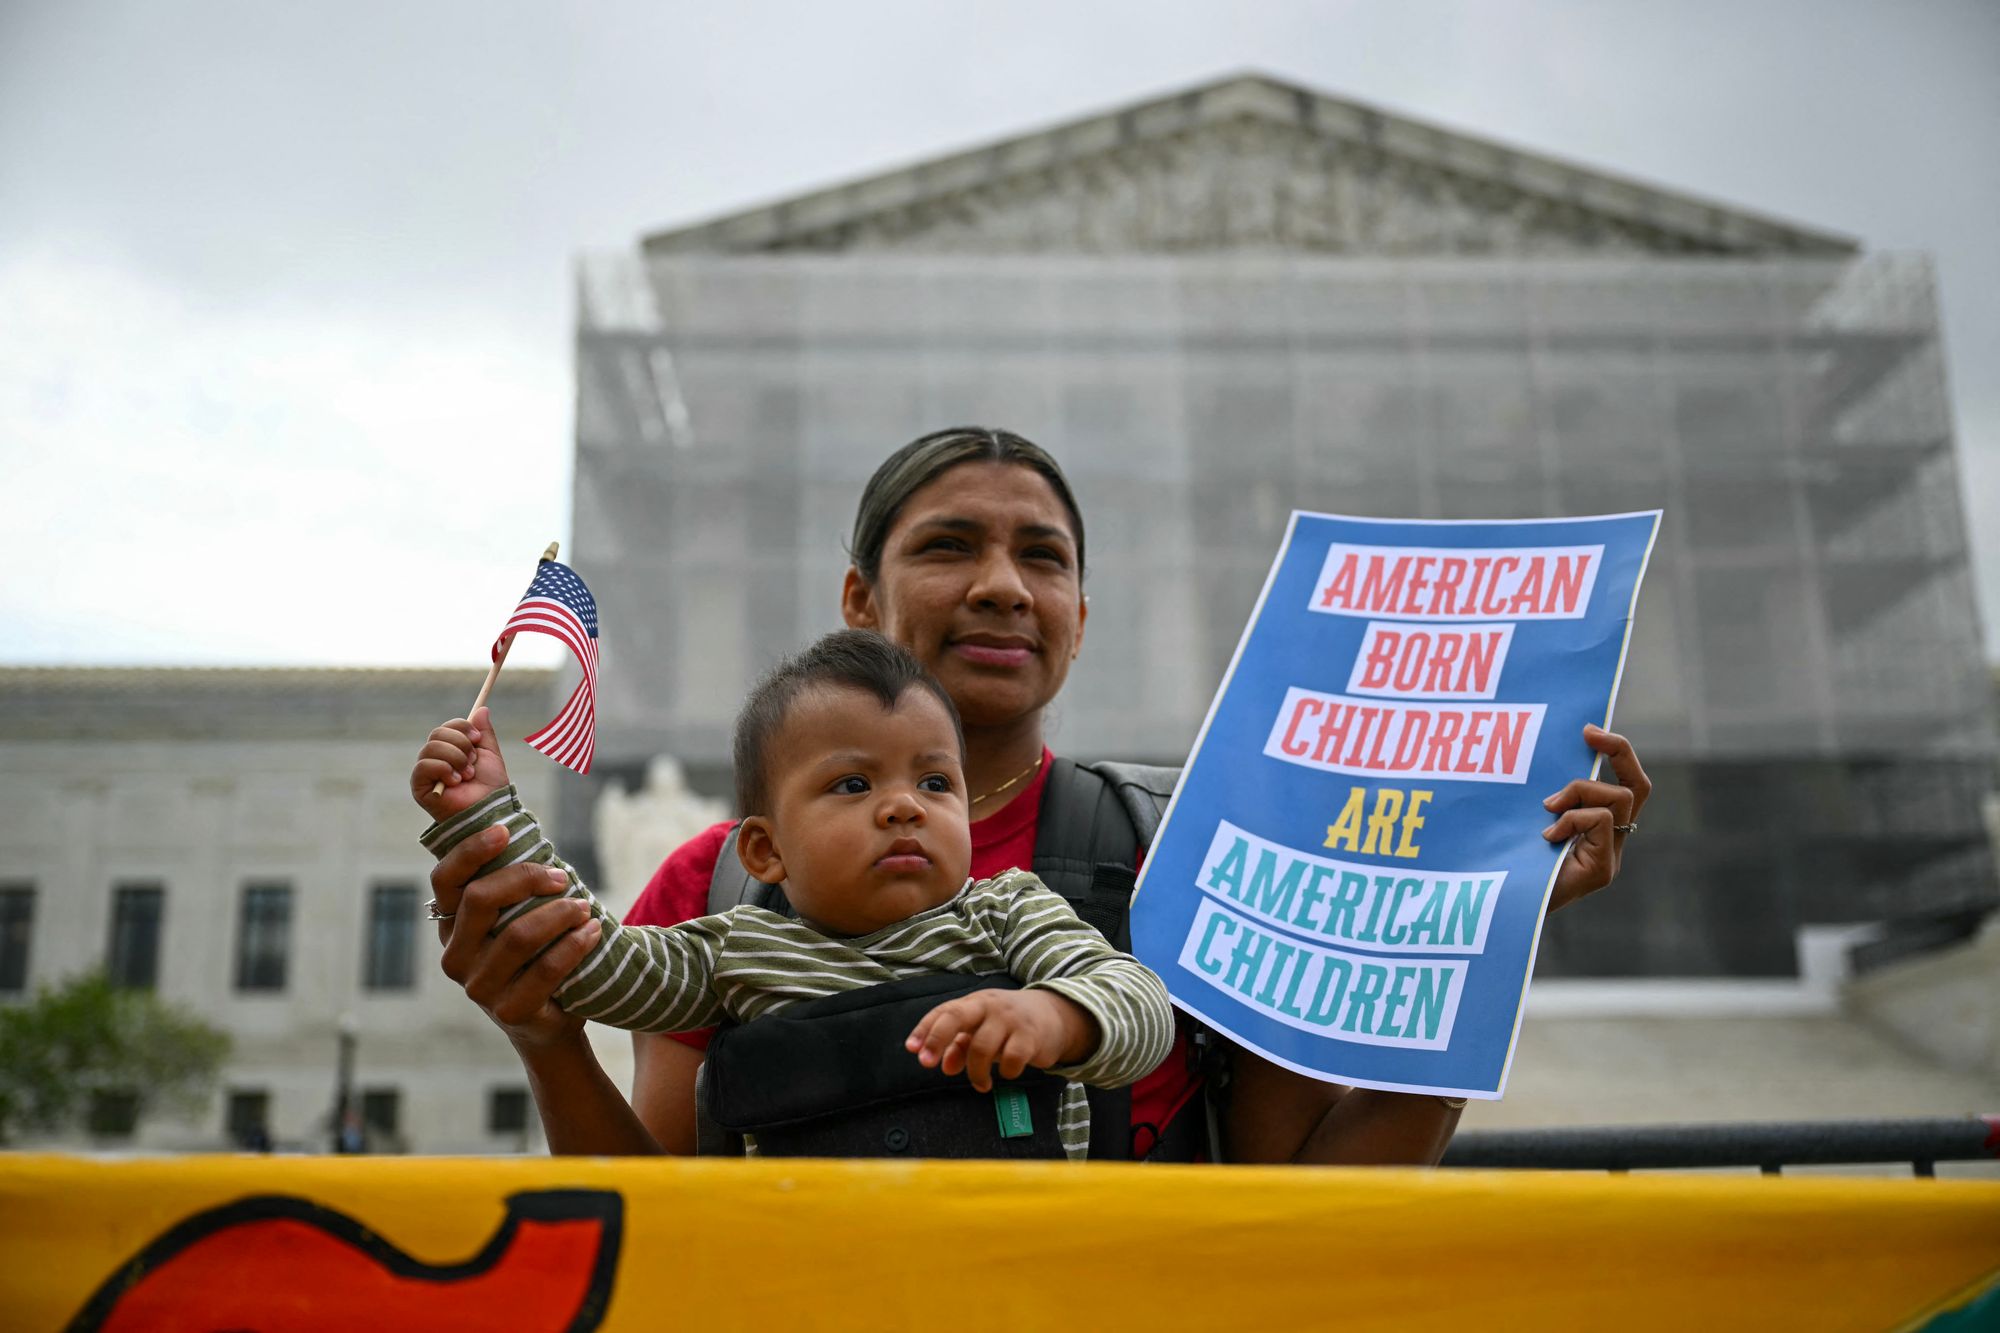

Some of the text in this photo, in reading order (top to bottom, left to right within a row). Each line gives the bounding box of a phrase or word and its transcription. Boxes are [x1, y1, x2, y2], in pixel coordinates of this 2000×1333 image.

[1320, 553, 1592, 616] AMERICAN
[1357, 629, 1503, 693] BORN
[1280, 697, 1532, 775] CHILDREN
[1323, 788, 1432, 857] ARE
[1208, 836, 1493, 946] AMERICAN
[1195, 911, 1455, 1040] CHILDREN
